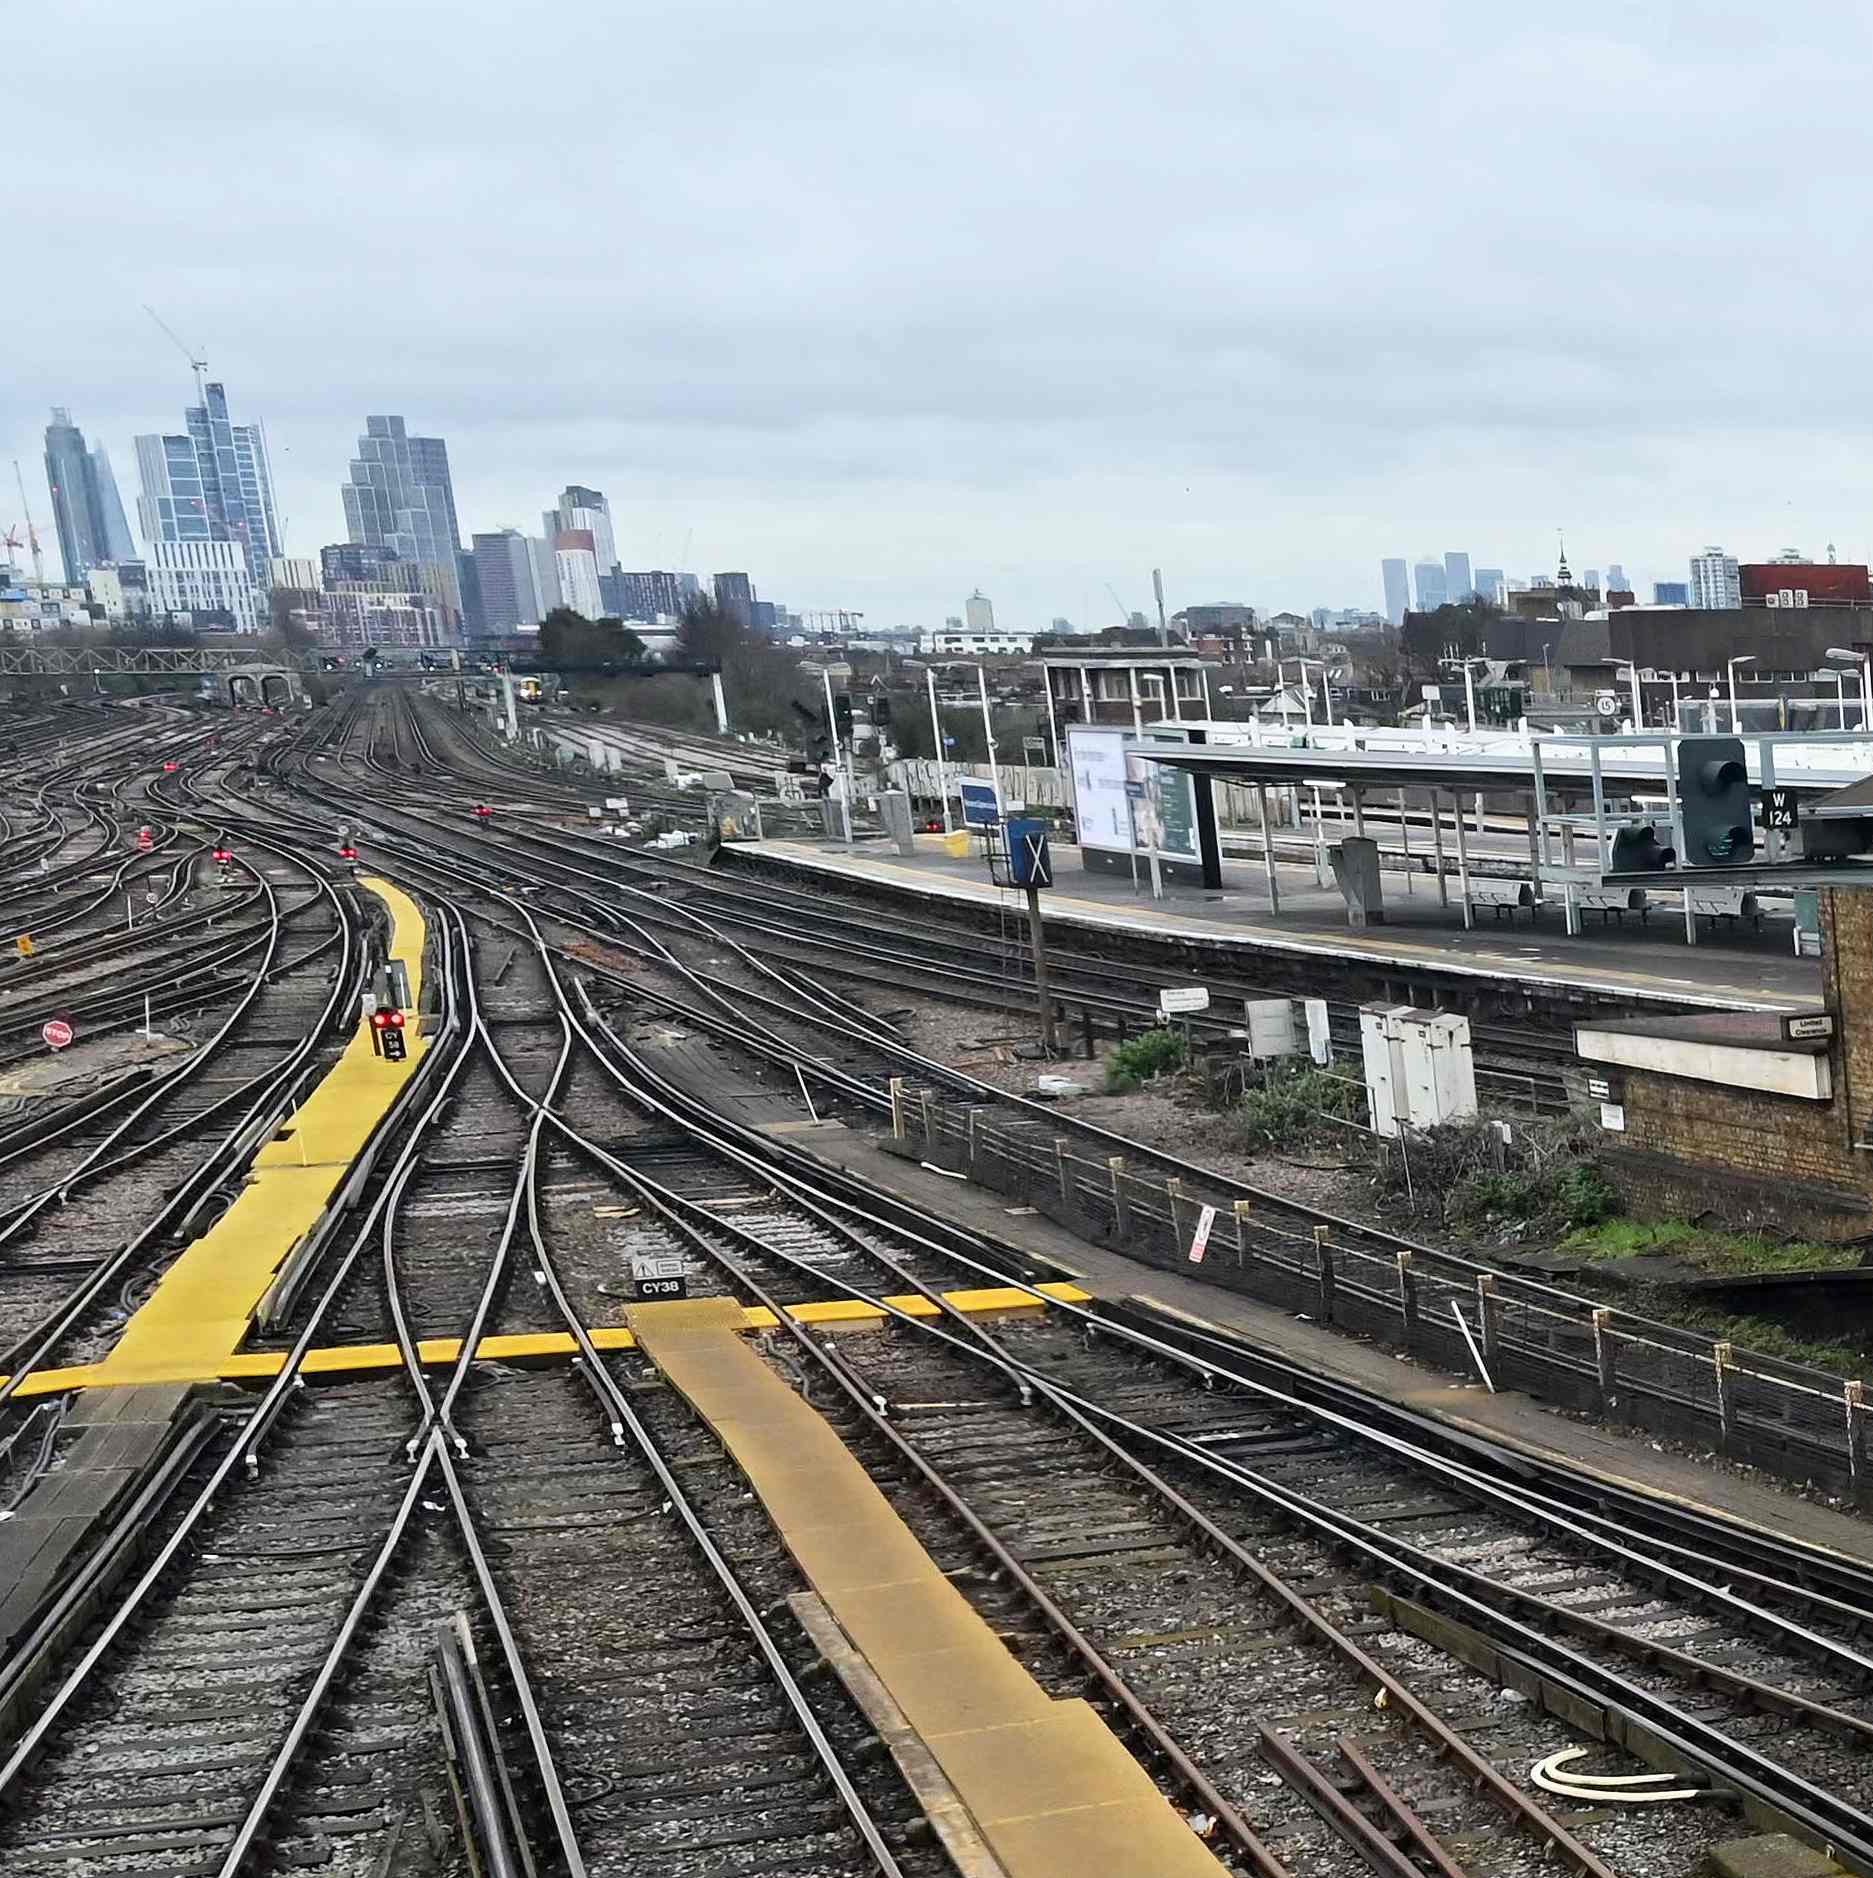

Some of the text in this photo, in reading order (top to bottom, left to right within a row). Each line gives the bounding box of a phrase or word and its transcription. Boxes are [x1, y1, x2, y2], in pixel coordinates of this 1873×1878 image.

[1772, 792, 1785, 807] W
[1769, 810, 1792, 826] 124
[642, 1280, 679, 1294] CY38
